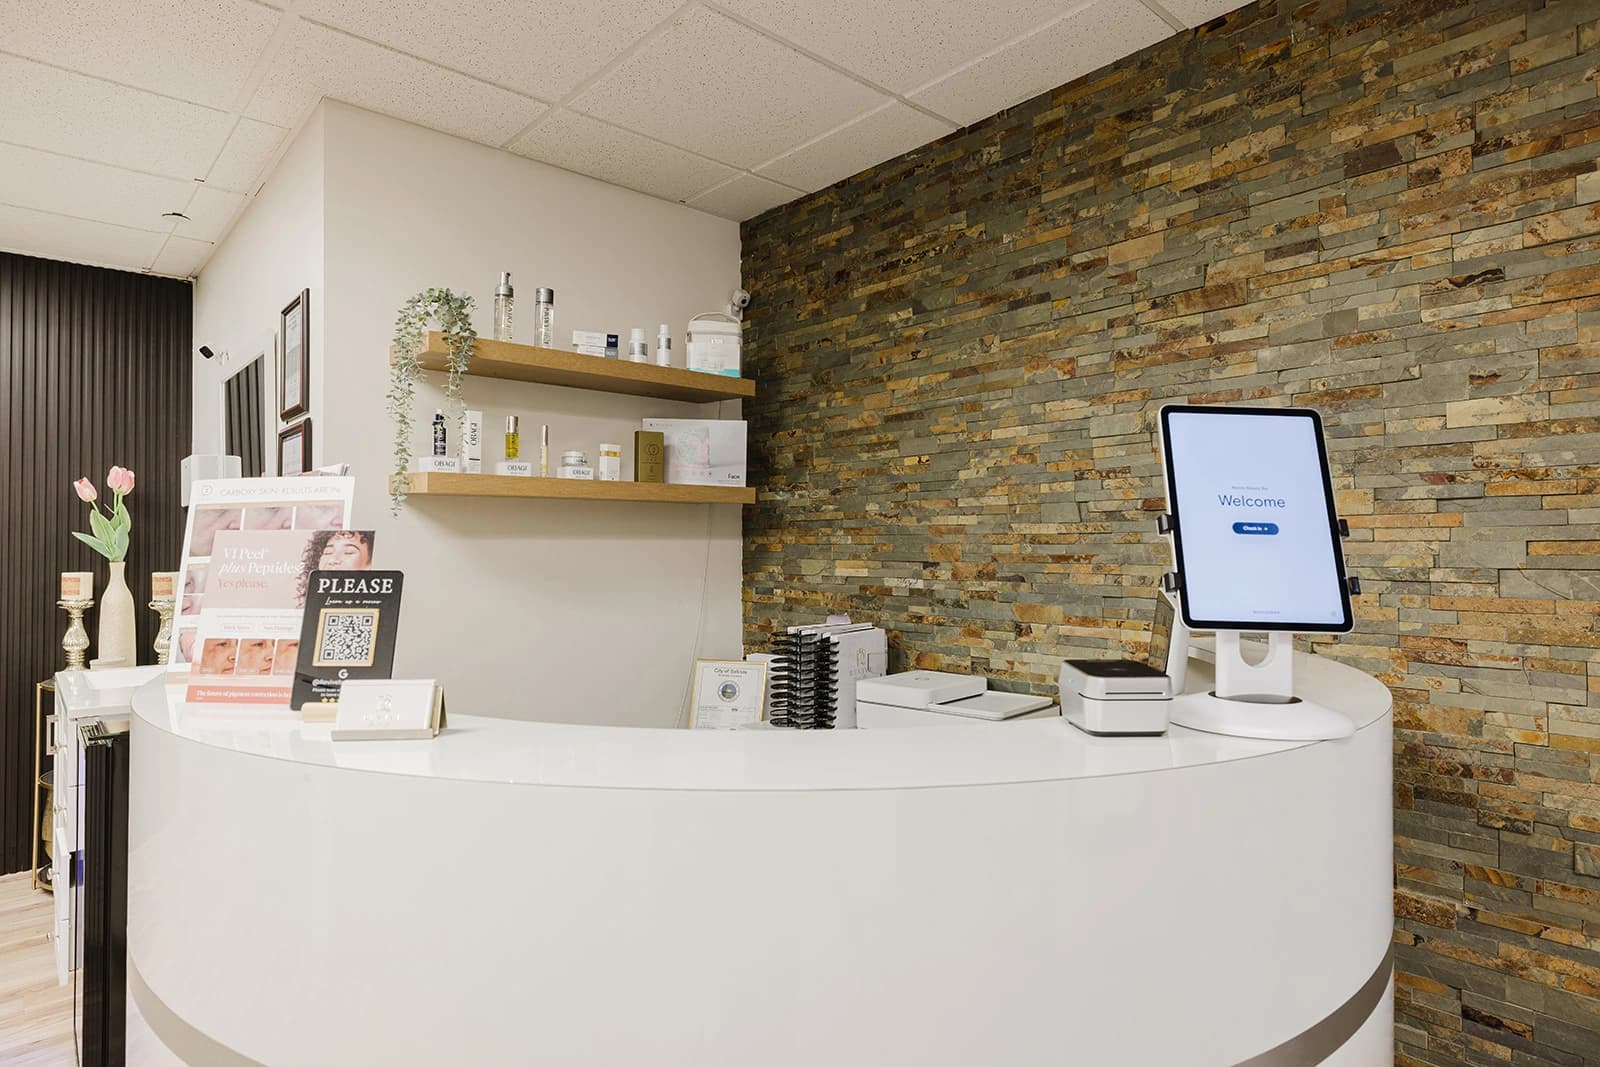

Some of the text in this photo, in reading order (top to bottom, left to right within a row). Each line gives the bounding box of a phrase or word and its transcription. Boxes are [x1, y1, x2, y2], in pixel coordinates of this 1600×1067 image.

[507, 464, 528, 472] OBAGI
[1218, 494, 1286, 508] Welcome
[224, 547, 238, 559] VI
[218, 561, 246, 576] plus
[217, 578, 233, 589] Yes
[317, 578, 393, 594] PLEASE
[325, 596, 343, 605] Leave
